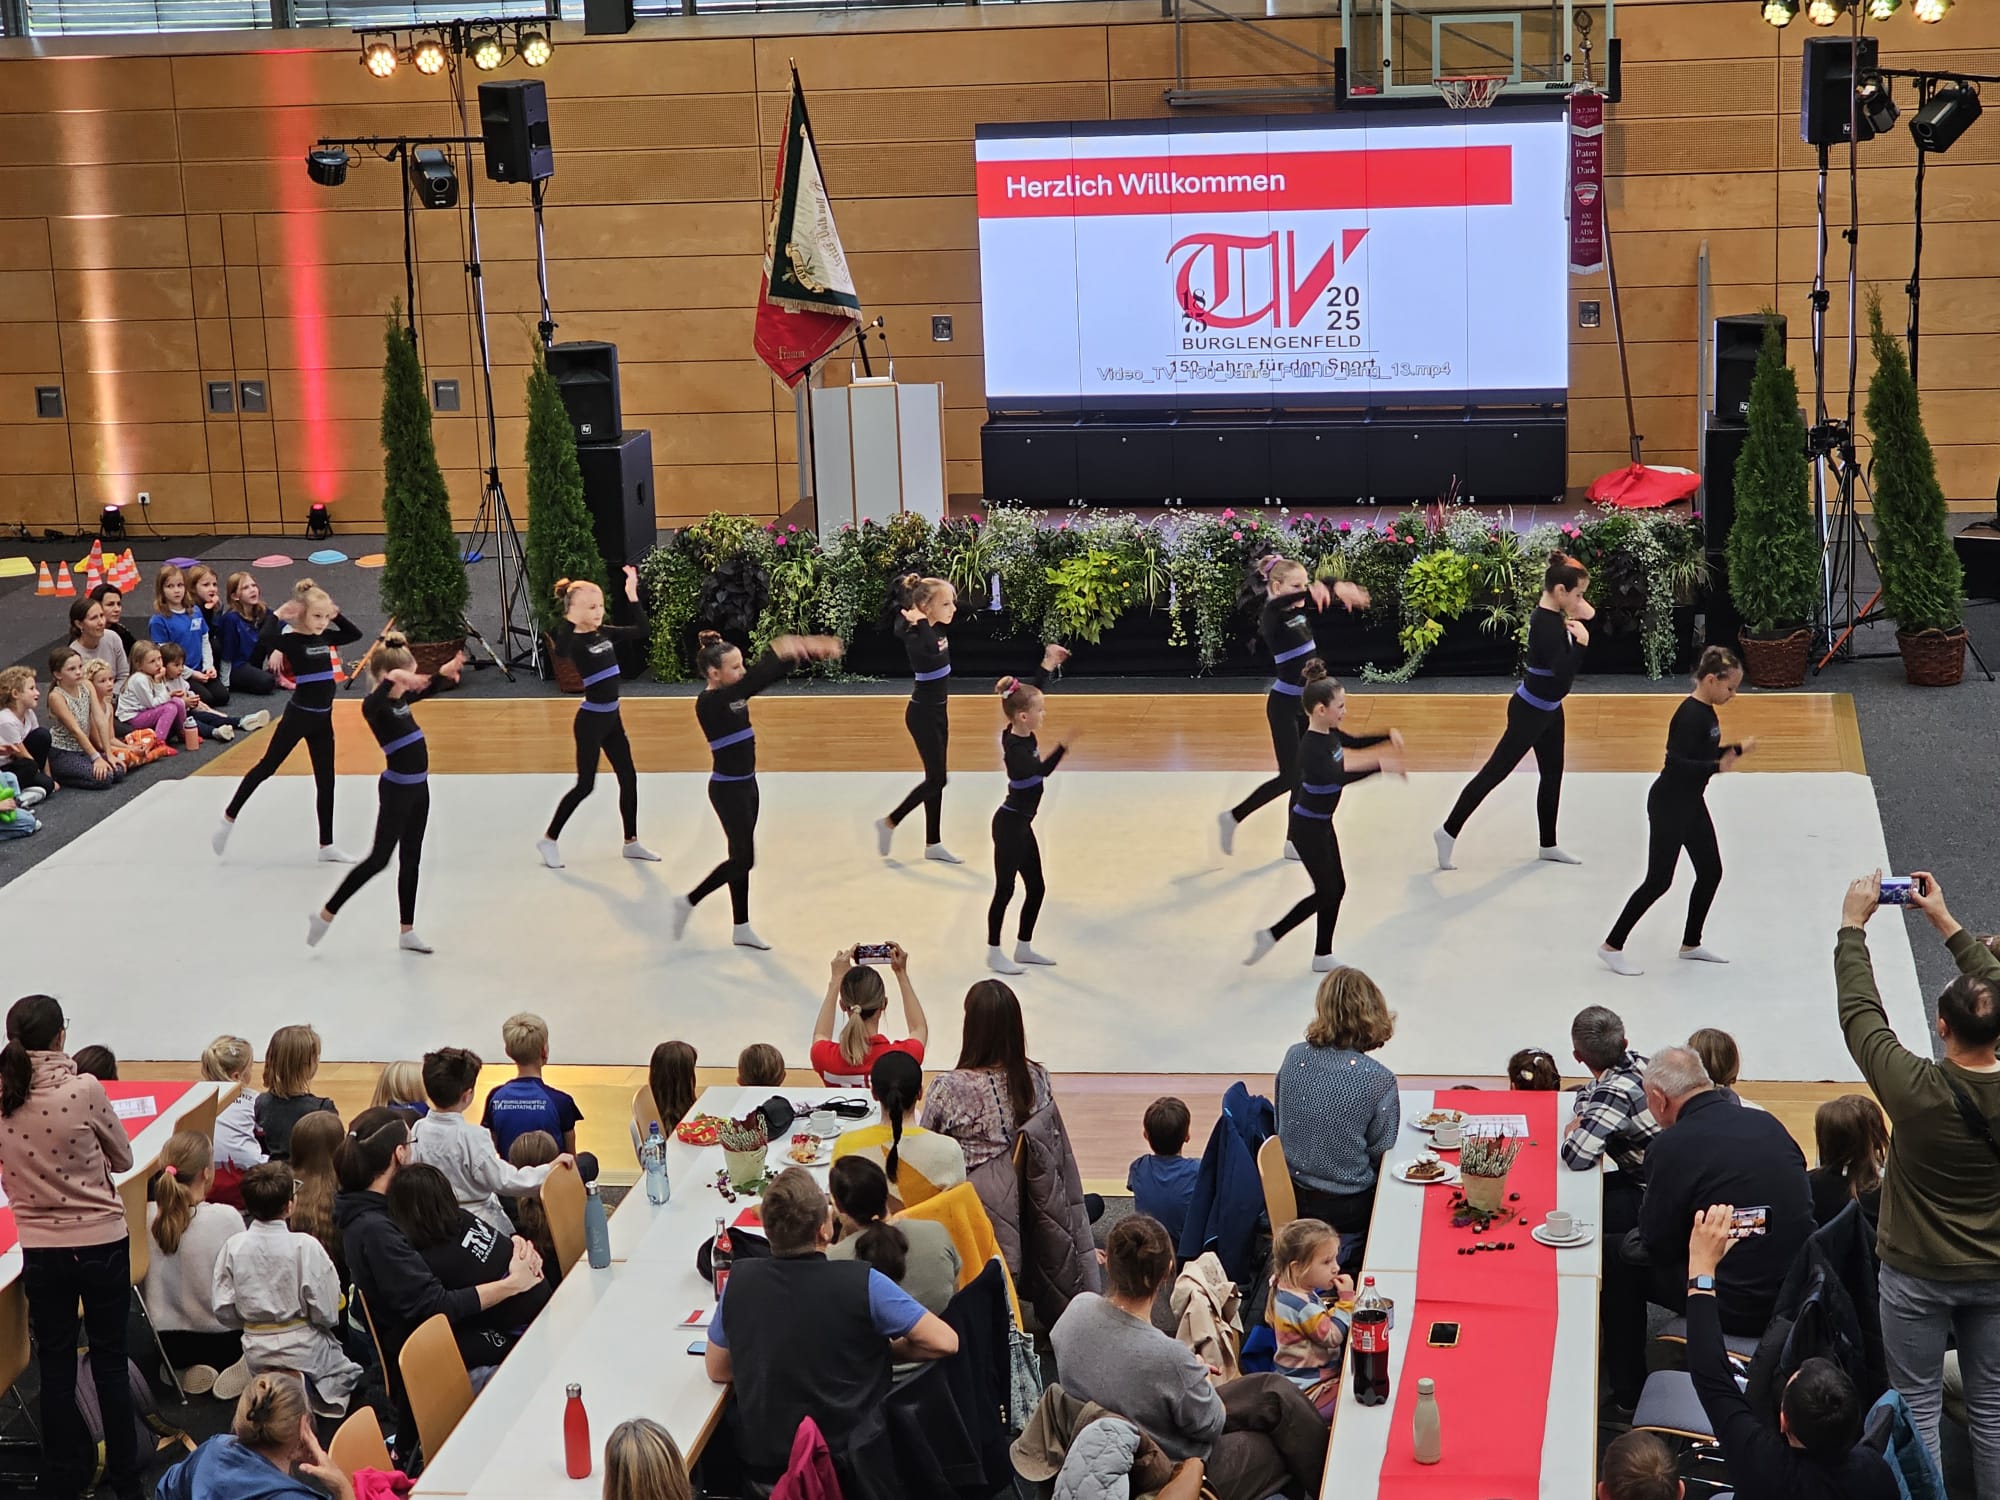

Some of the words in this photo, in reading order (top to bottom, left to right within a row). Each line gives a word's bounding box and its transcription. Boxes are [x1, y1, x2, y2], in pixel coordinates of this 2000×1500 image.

[1576, 149, 1597, 158] Paten
[1576, 165, 1597, 175] Dank
[1006, 174, 1113, 199] Herzlich
[1118, 172, 1286, 196] Willkommen
[1181, 288, 1206, 312] 18
[1326, 286, 1360, 307] 20
[1182, 311, 1207, 333] 75
[1327, 310, 1361, 330] 25
[1182, 334, 1362, 350] BURGLENGENFELD
